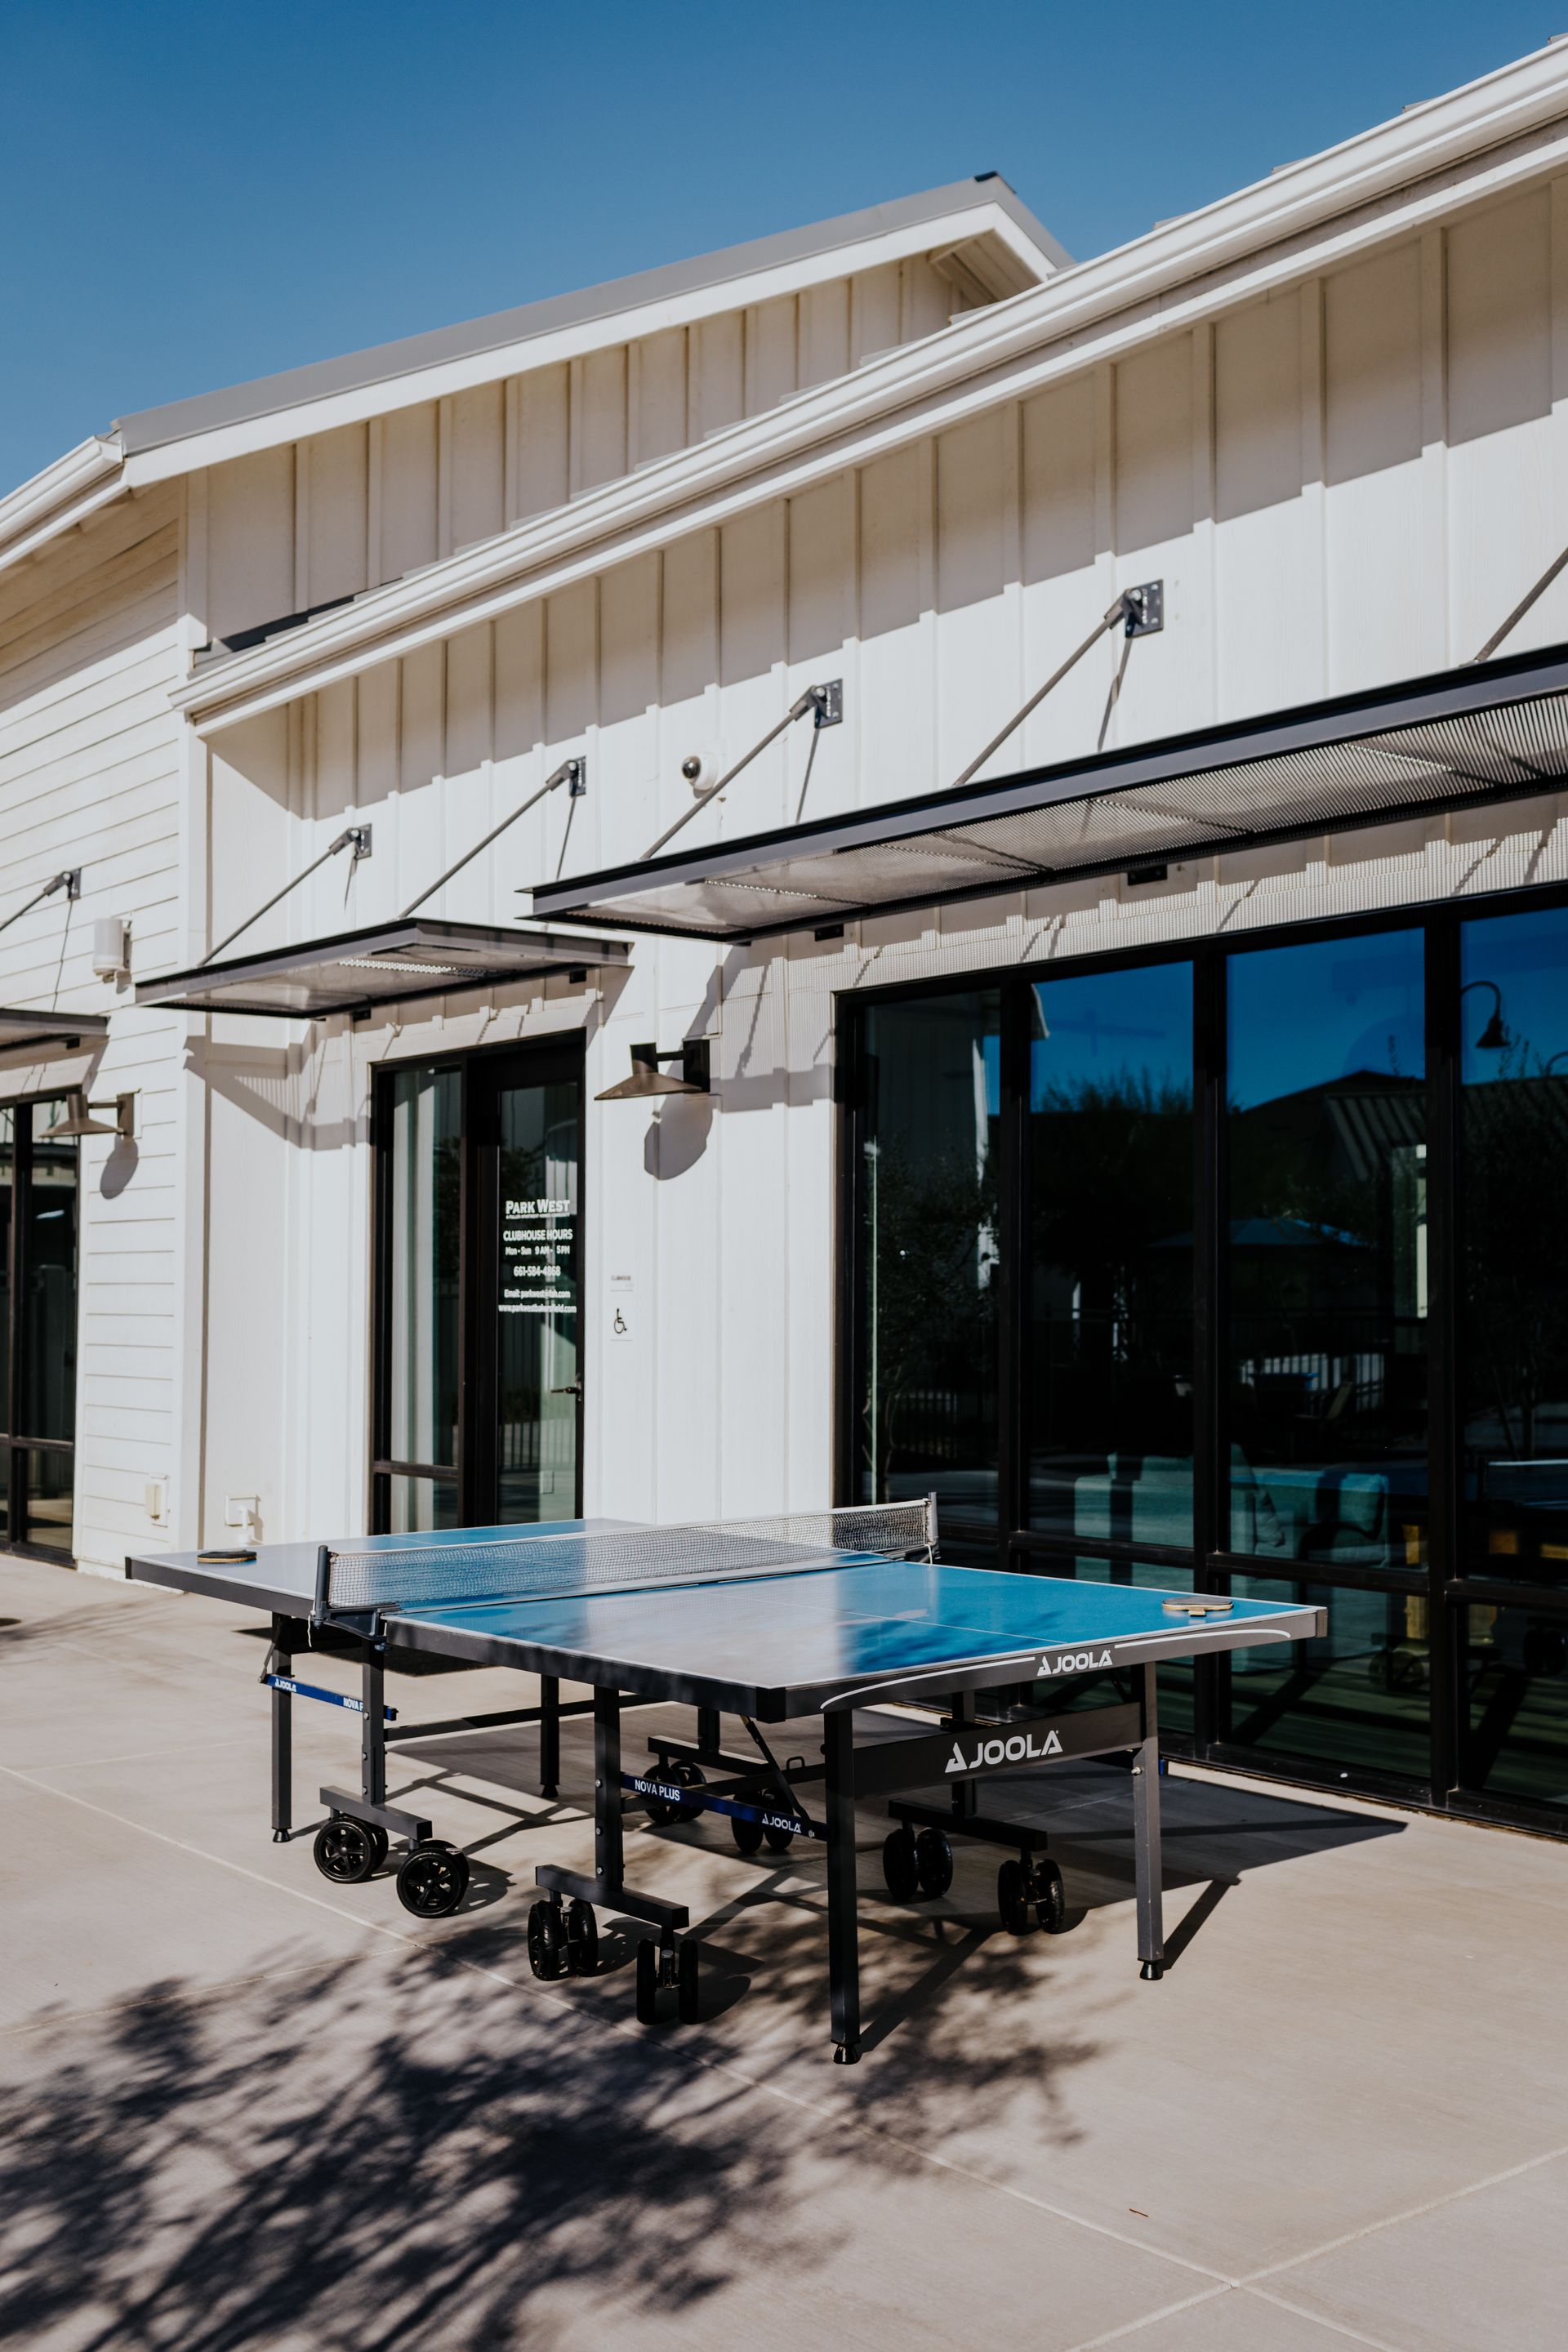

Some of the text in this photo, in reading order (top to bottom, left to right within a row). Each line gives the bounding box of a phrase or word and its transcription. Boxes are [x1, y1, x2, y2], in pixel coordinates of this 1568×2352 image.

[506, 1199, 571, 1214] PARK WEST
[503, 1229, 573, 1241] CLUBHOUSE HOURS
[1052, 1650, 1113, 1674] JOOLA
[343, 1696, 359, 1711] NOVA
[969, 1730, 1063, 1769] JOOLA
[635, 1780, 680, 1801] NOVA PLUS
[769, 1816, 801, 1833] JOOLA
